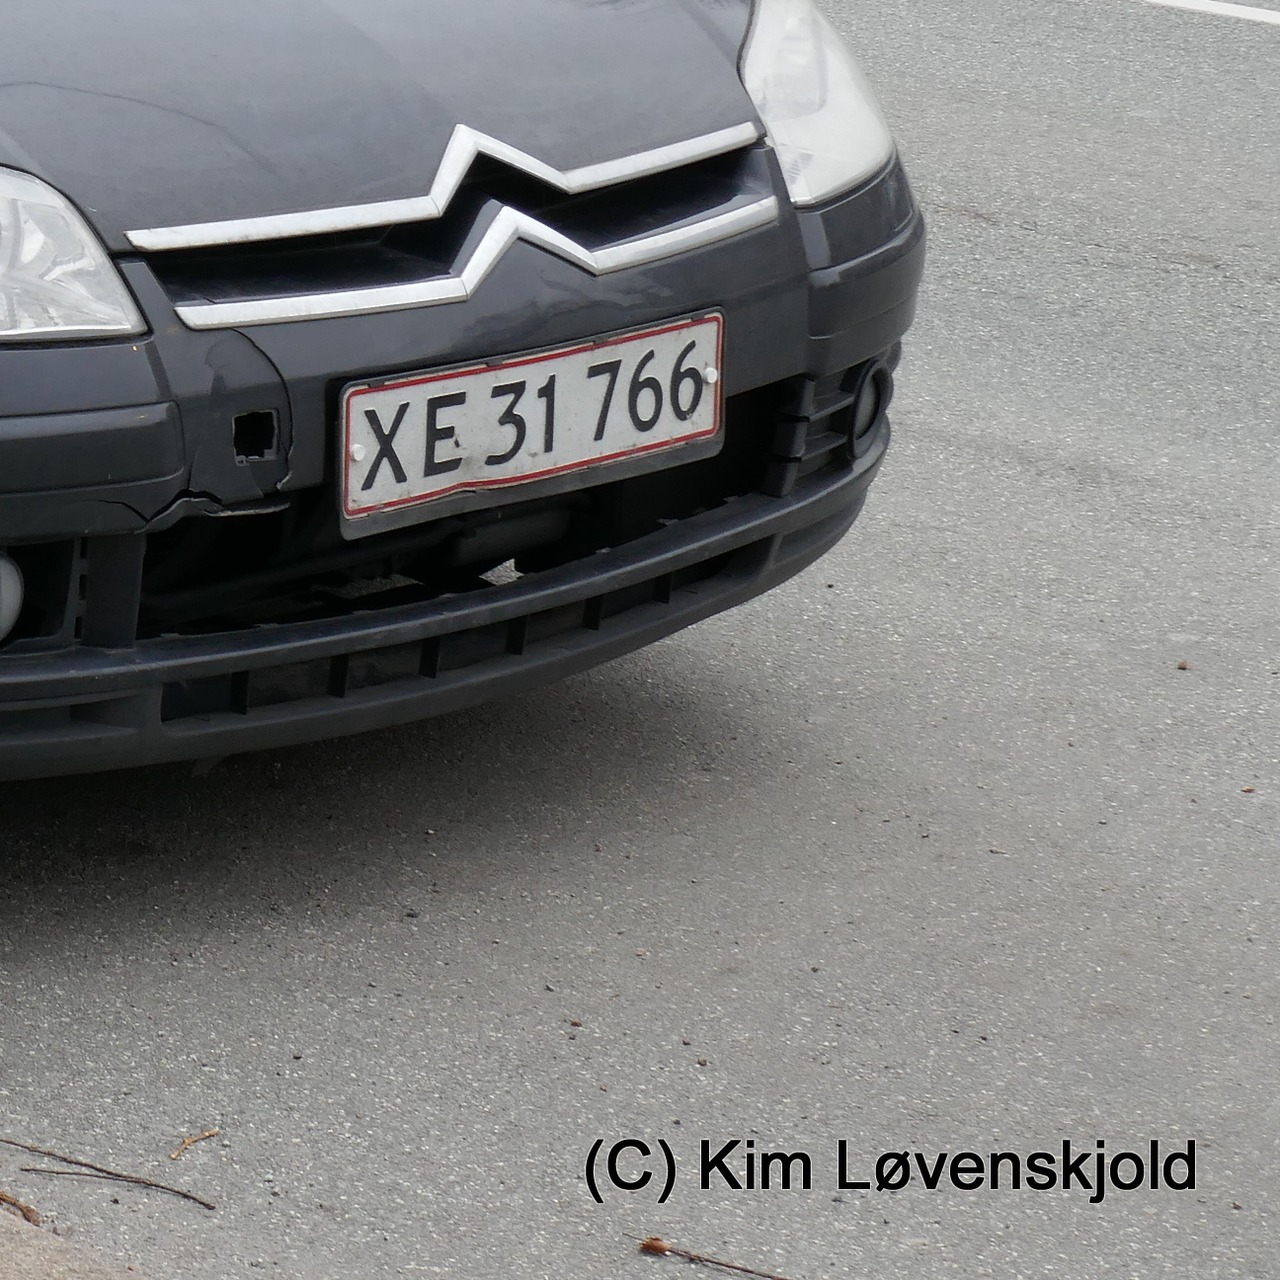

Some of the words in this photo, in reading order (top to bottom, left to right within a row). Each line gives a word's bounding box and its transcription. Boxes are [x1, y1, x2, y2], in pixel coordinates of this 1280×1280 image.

[360, 391, 467, 491] XE
[484, 373, 557, 467] 31
[586, 339, 704, 442] 766
